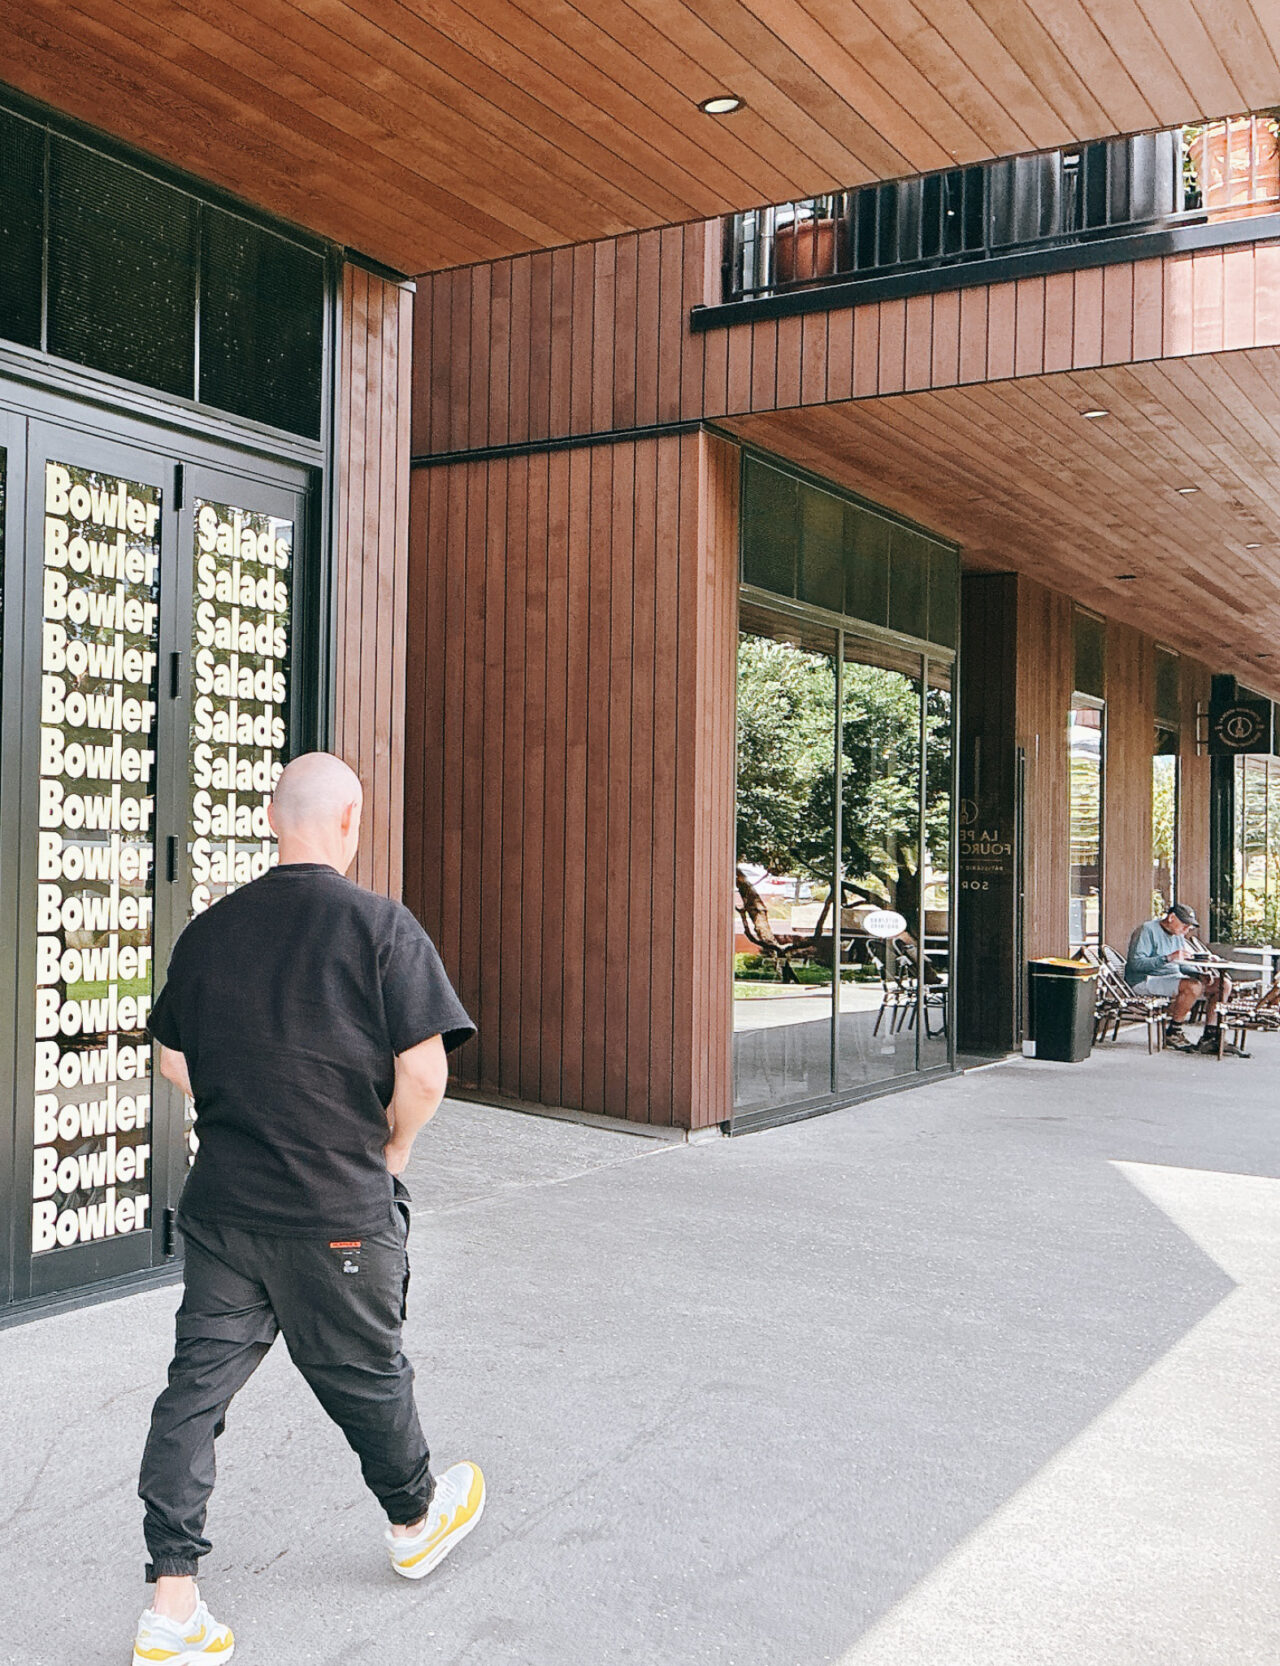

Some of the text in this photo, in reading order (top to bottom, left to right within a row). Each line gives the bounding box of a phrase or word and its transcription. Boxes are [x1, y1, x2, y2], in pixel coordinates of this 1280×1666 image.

[46, 462, 159, 536] Bowler
[199, 506, 289, 569] Salads
[45, 514, 158, 585] Bowler
[197, 553, 288, 614] Salads
[44, 567, 158, 633] Bowler
[196, 601, 287, 659] Salads
[43, 620, 156, 683] Bowler
[195, 649, 286, 704] Salads
[42, 673, 155, 731] Bowler
[194, 697, 285, 749] Salads
[41, 725, 154, 781] Bowler
[194, 743, 284, 792] Salads
[40, 778, 154, 830] Bowler
[193, 790, 278, 838] Salad
[39, 831, 153, 880] Bowler
[38, 884, 152, 934] Bowler
[37, 936, 151, 986] Bowler
[36, 986, 151, 1039] Bowler
[35, 1036, 150, 1093] Bowler
[34, 1087, 150, 1146] Bowler
[33, 1137, 150, 1199] Bowler
[32, 1187, 149, 1253] Bowler
